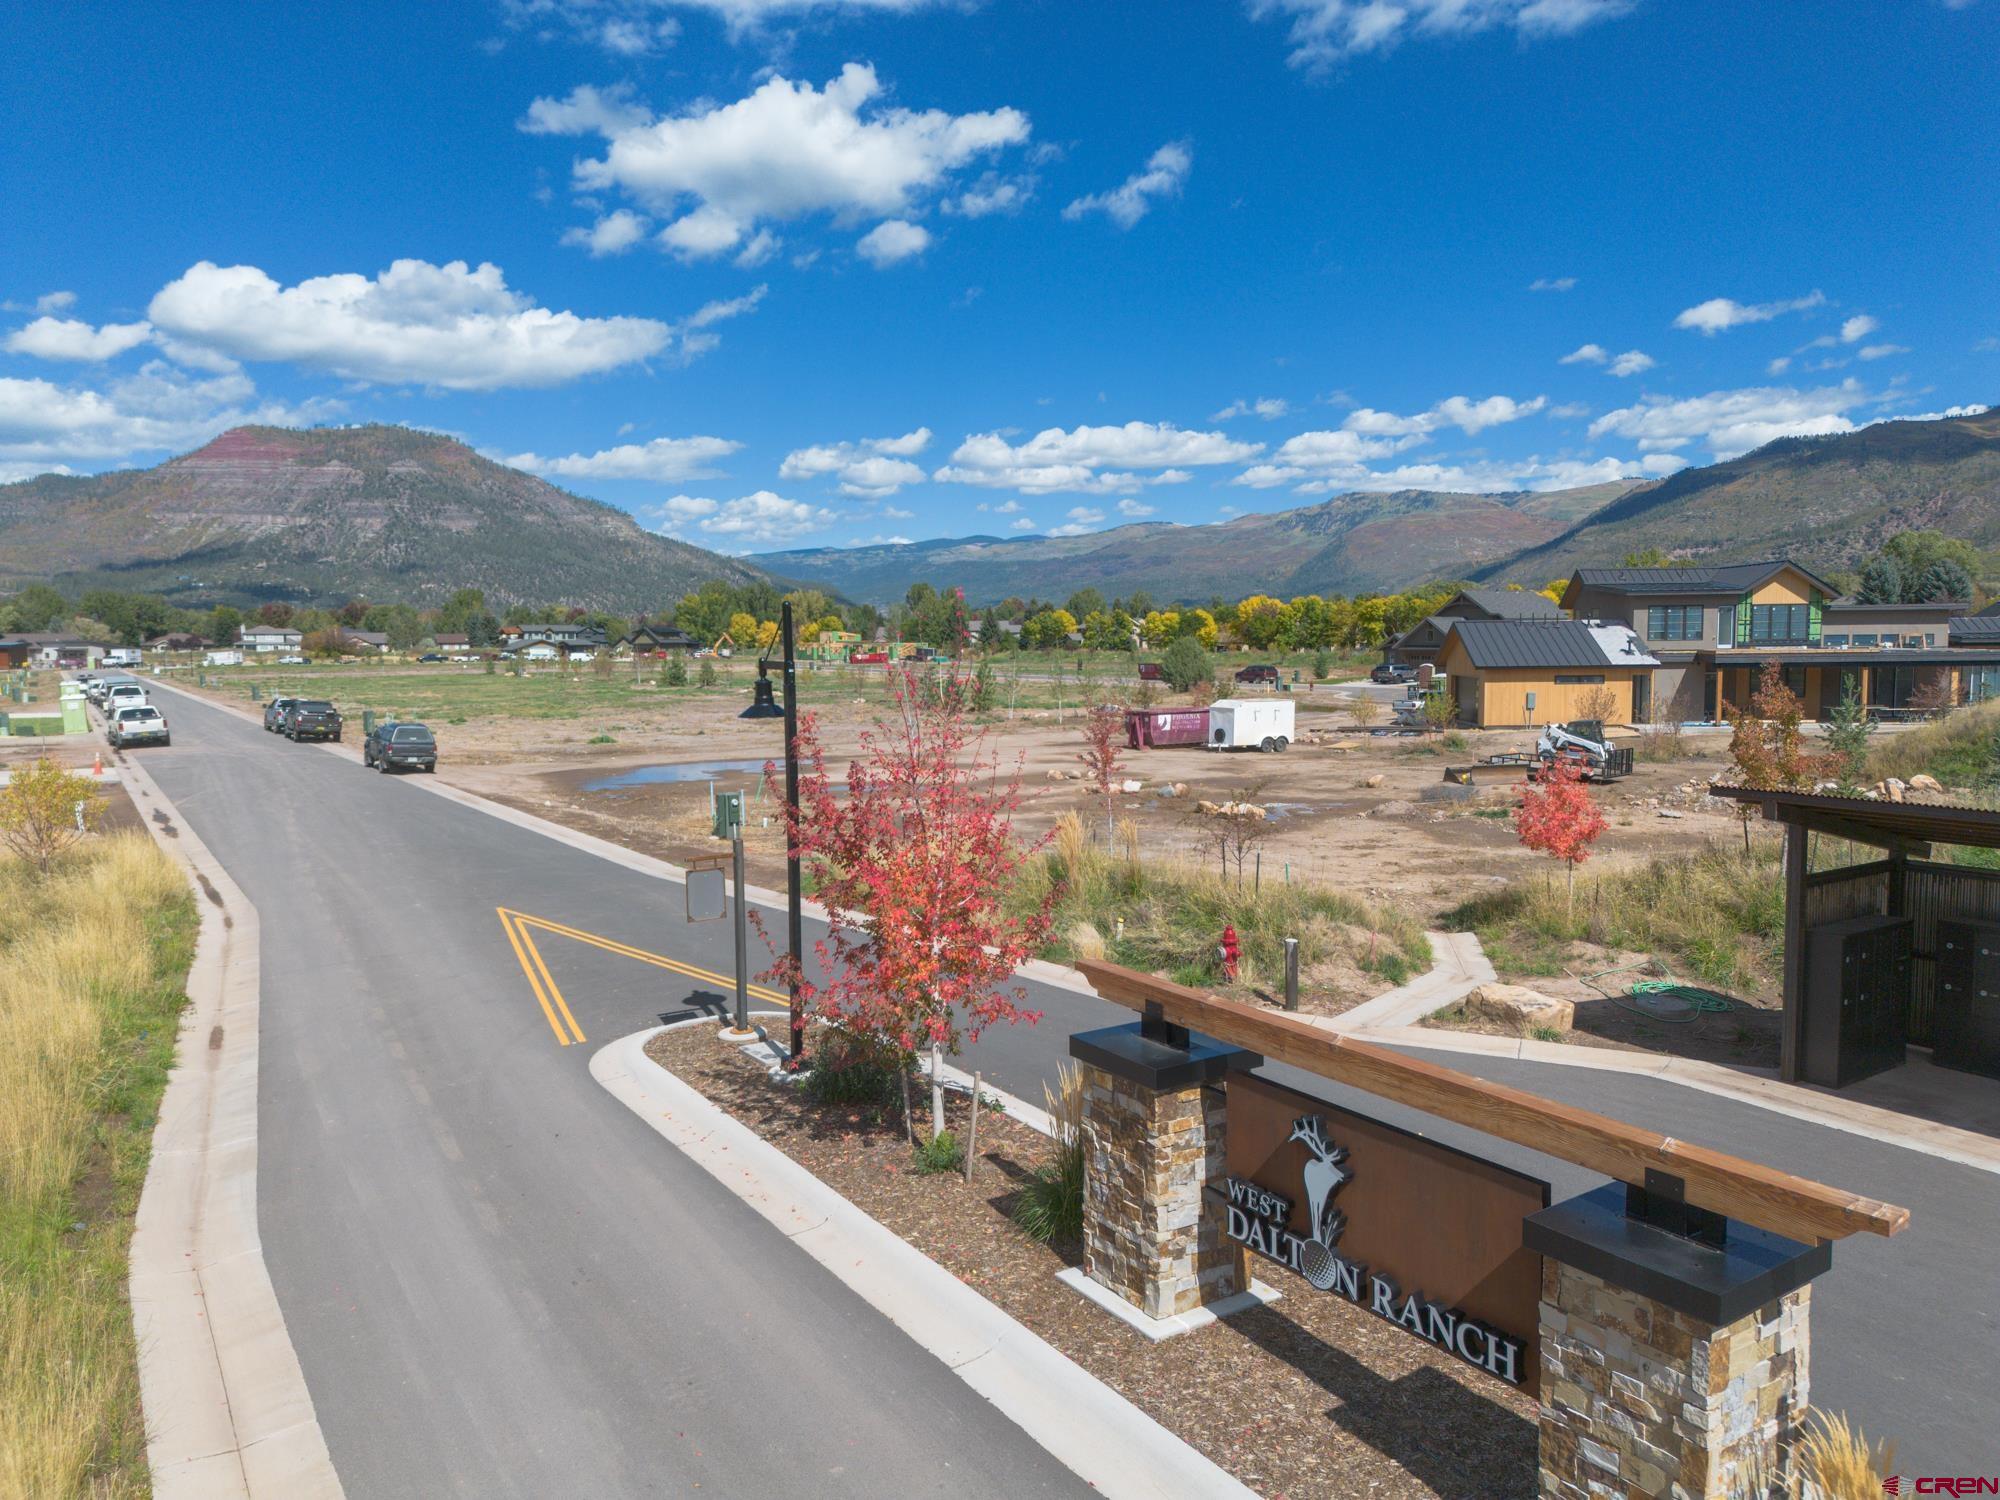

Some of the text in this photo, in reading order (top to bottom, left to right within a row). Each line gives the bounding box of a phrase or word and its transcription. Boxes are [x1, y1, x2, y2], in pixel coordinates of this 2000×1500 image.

[1226, 1177, 1288, 1223] WEST
[1226, 1204, 1519, 1385] DALTON RANCH
